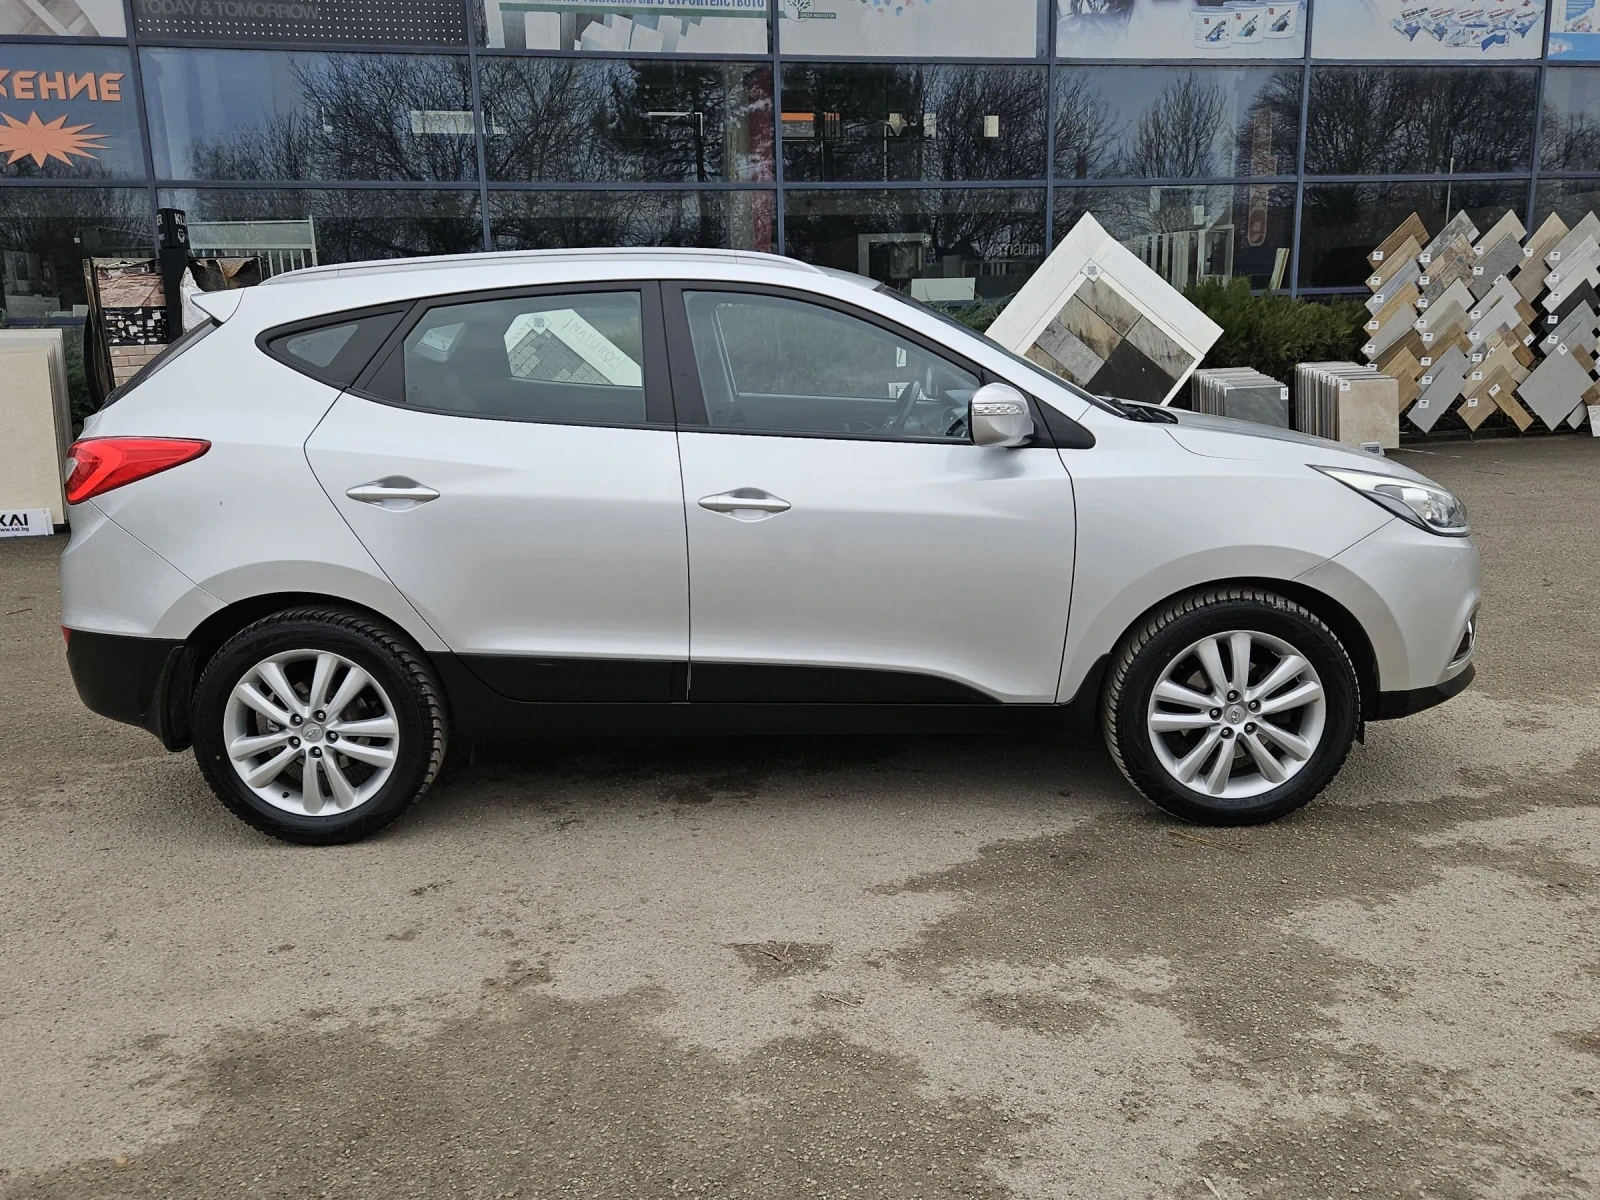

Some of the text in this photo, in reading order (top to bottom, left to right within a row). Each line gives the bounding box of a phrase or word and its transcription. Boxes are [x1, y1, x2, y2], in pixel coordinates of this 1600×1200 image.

[139, 0, 318, 19] TODAY & TOMORROW
[569, 320, 616, 363] NATURO
